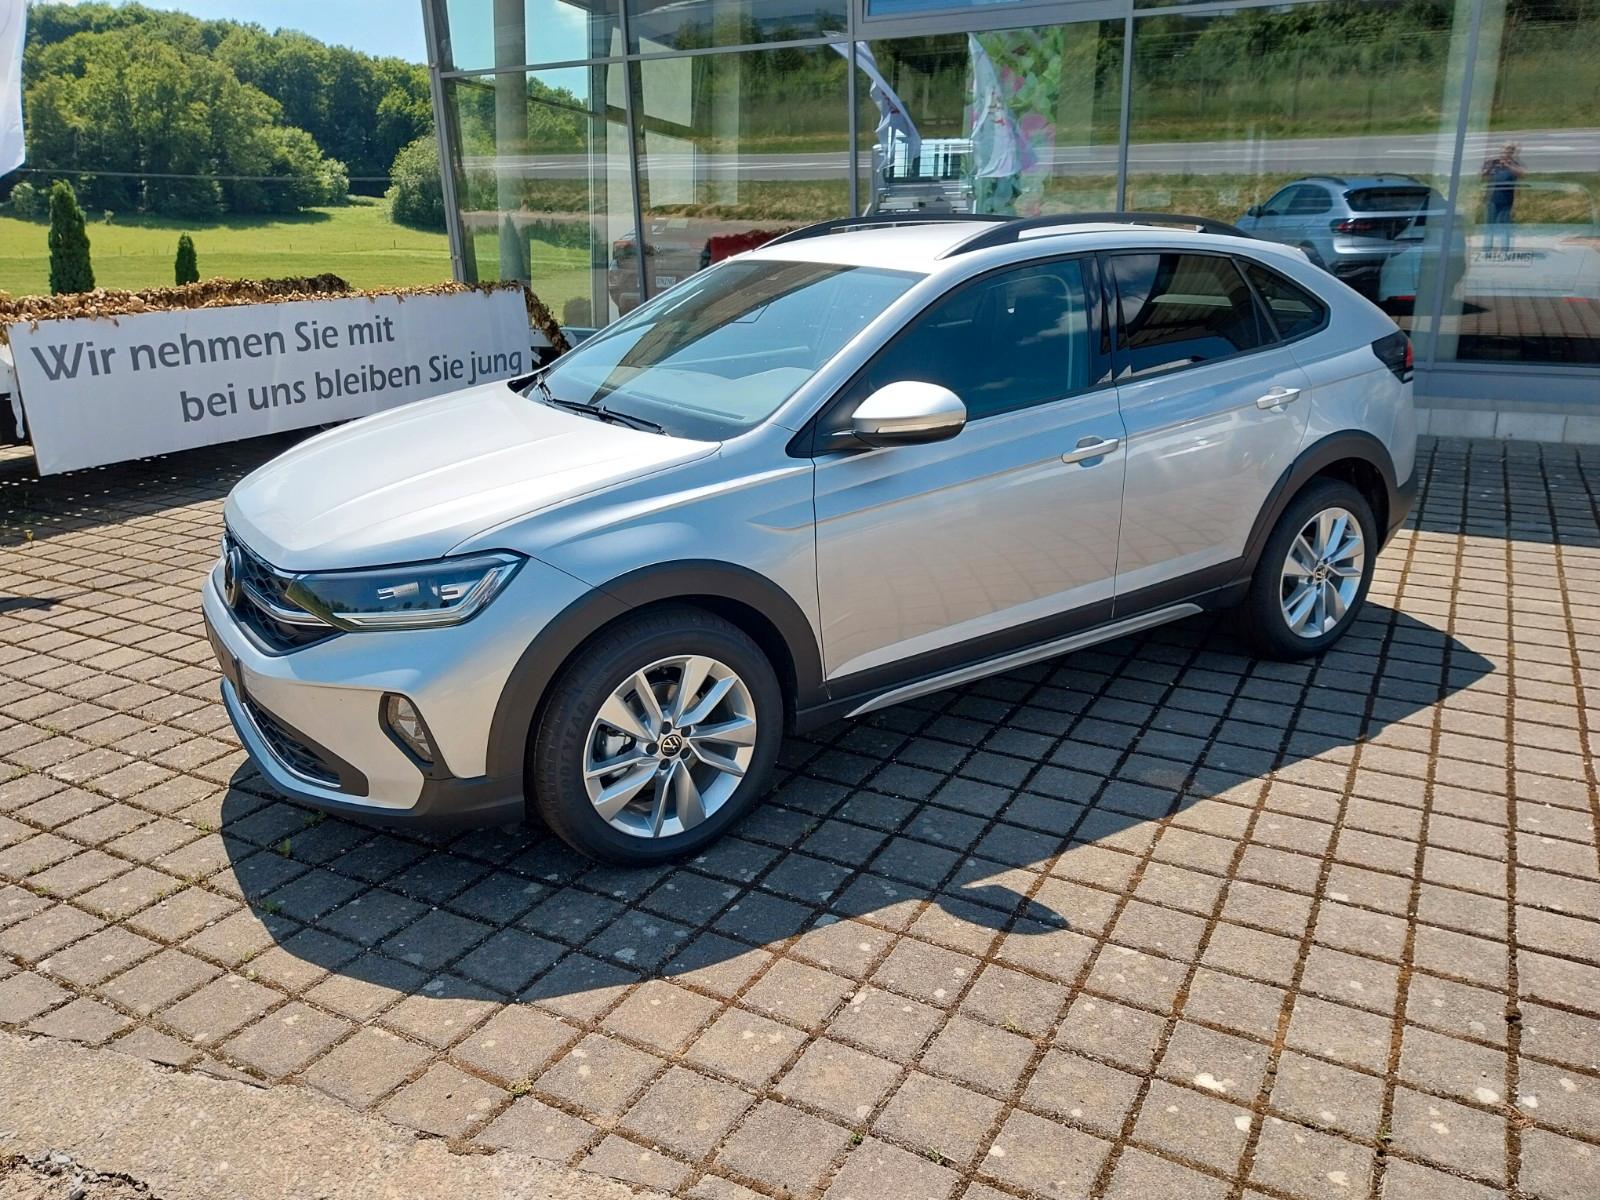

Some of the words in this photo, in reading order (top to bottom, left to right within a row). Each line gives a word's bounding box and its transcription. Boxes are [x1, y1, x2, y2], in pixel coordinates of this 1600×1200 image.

[30, 341, 116, 381] Wir
[129, 332, 286, 371] nehmen
[294, 319, 339, 352] Sie
[347, 315, 395, 345] mit
[180, 383, 238, 423] bei
[248, 379, 307, 410] uns
[314, 363, 421, 400] bleiben
[428, 351, 464, 383] Sie
[468, 350, 522, 385] jung
